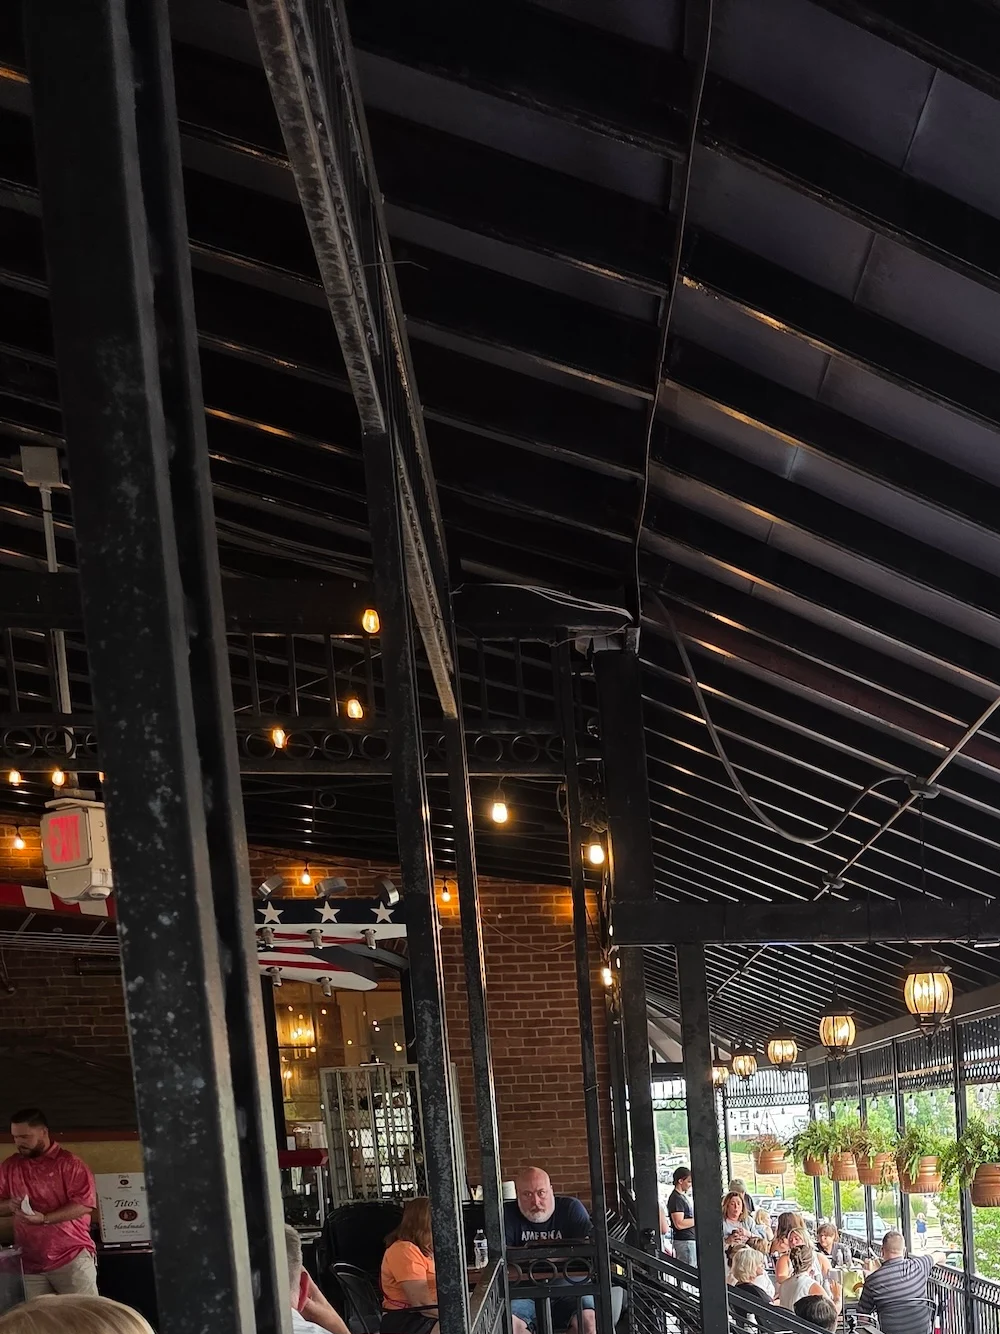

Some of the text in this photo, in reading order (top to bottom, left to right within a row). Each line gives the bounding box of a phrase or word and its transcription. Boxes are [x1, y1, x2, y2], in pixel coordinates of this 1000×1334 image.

[48, 814, 81, 865] EXIT
[114, 1199, 140, 1208] Tito's
[521, 1229, 563, 1242] AMERICA
